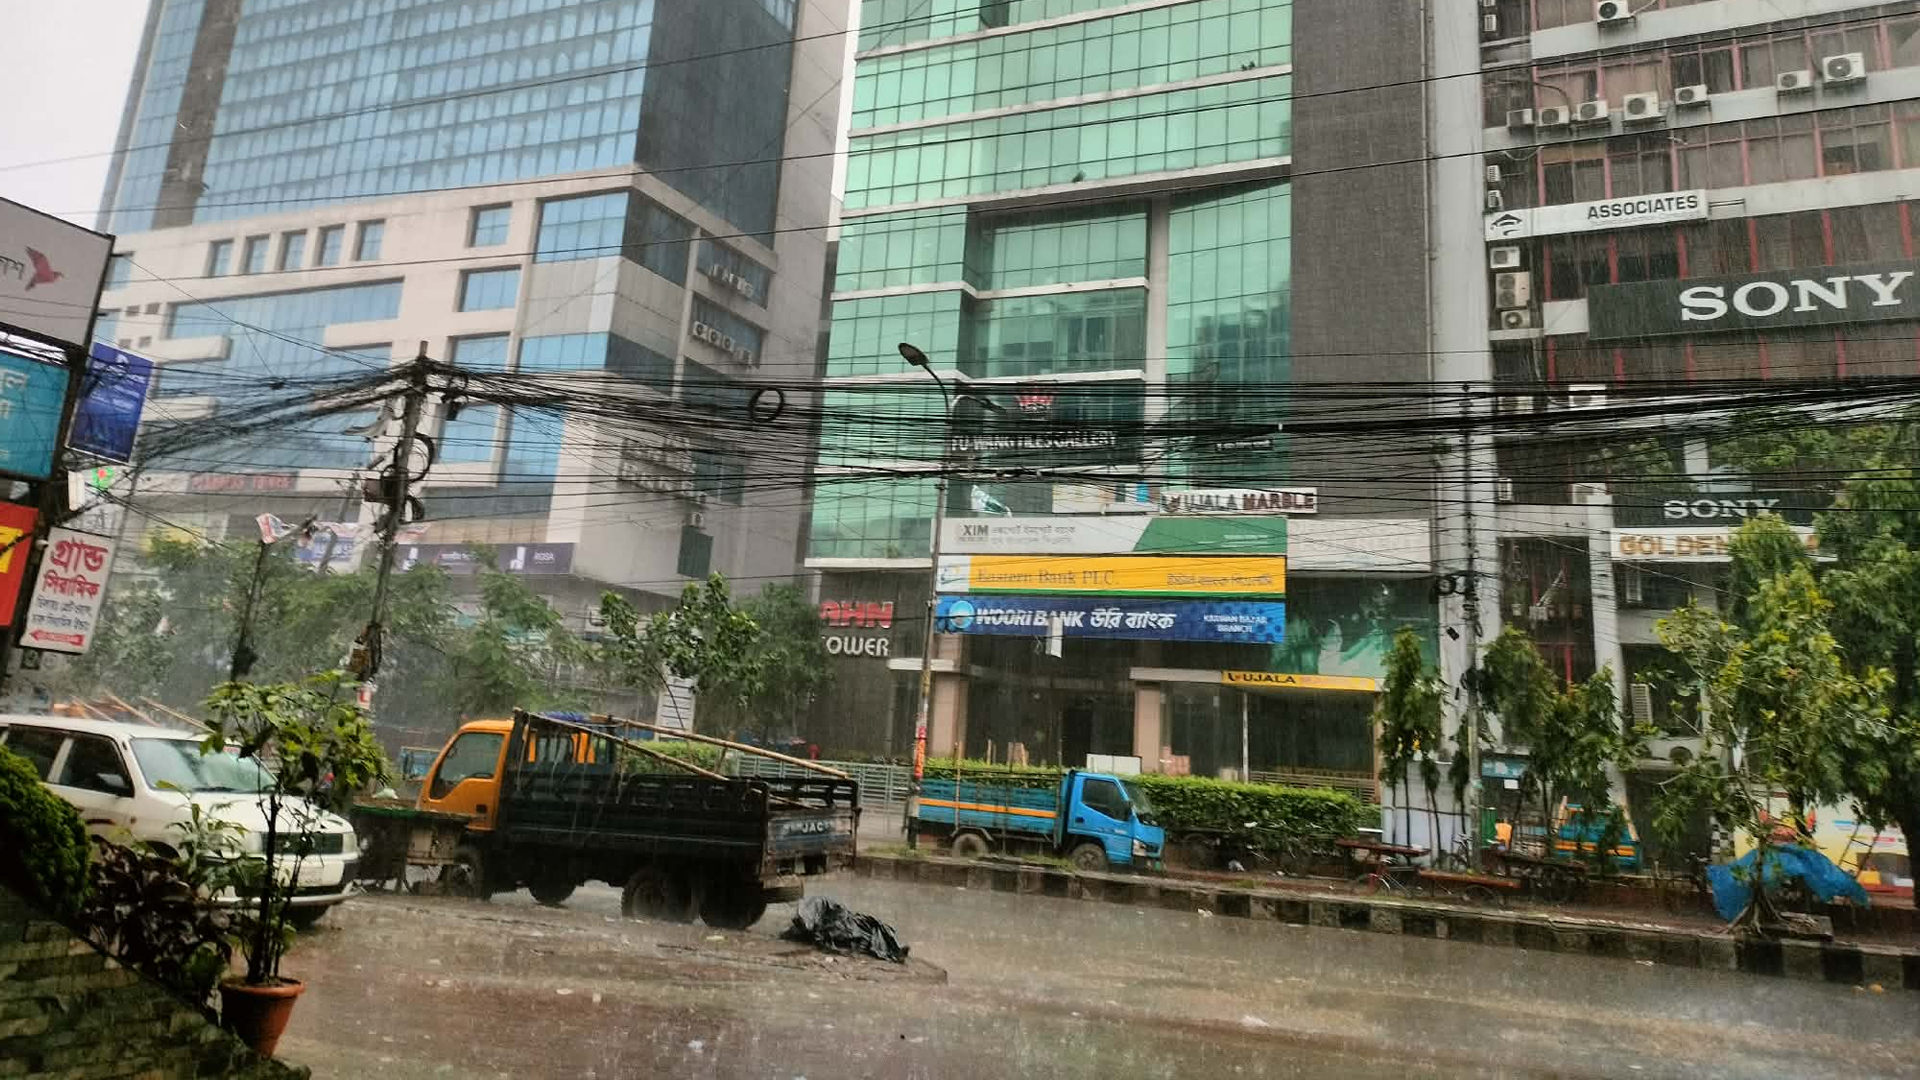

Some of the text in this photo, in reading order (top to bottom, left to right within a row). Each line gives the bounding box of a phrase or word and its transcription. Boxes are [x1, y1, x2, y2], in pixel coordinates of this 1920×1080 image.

[1587, 195, 1699, 220] ASSOCIATES
[1678, 271, 1914, 322] SONY
[1242, 493, 1314, 511] MARBLE
[1663, 498, 1781, 520] SONY
[1038, 569, 1076, 585] Bank
[1090, 606, 1178, 630] উরি ব্যাংক
[821, 635, 890, 657] OWER
[1243, 673, 1297, 685] UJALA
